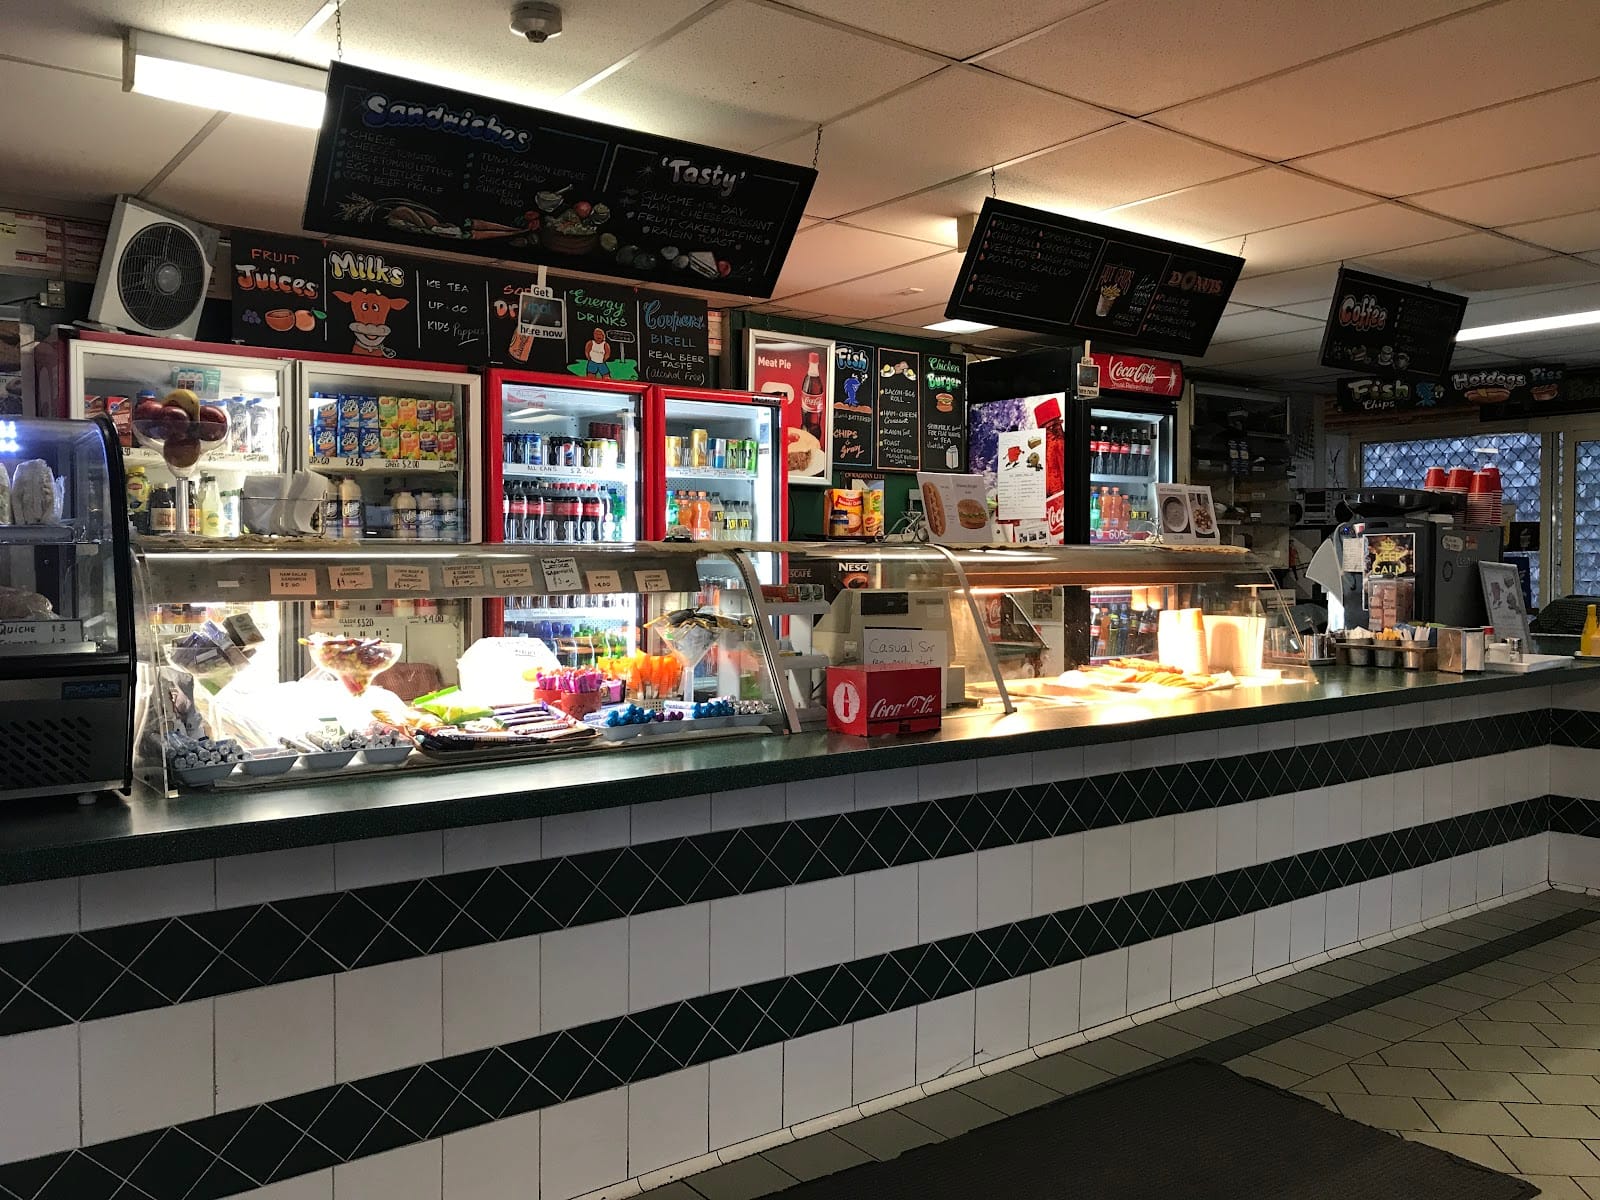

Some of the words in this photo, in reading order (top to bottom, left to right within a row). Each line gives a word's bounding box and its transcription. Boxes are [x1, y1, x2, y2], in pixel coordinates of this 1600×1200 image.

[364, 95, 533, 152] Sandwiches
[637, 212, 678, 226] FRUIT
[251, 248, 300, 265] FRUIT
[329, 251, 405, 287] Milks
[235, 264, 319, 299] Juices
[426, 279, 441, 289] ICE
[446, 282, 470, 293] TEA
[533, 286, 551, 298] Get
[569, 288, 625, 317] Energy
[576, 311, 628, 328] DRINKS
[1339, 294, 1388, 331] Coffee
[427, 320, 450, 333] KIDS
[520, 324, 541, 336] here
[542, 330, 563, 338] now
[651, 333, 697, 348] BIRELL
[648, 349, 676, 361] REAL
[679, 353, 705, 364] BEER
[757, 356, 777, 368] Meat
[778, 358, 792, 370] Pie
[836, 346, 869, 372] Fish
[660, 360, 693, 371] TASTE
[928, 356, 961, 373] Chicken
[1110, 361, 1156, 385] Coca-Cola
[1451, 371, 1527, 390] Hotdogs
[1530, 367, 1563, 381] Pies
[926, 372, 963, 391] Burger
[1347, 379, 1411, 401] Fish
[1362, 400, 1396, 410] Chips
[833, 429, 859, 440] CHIPS
[402, 460, 419, 468] $2.00
[0, 624, 36, 634] QUICHE
[869, 638, 914, 653] Casual
